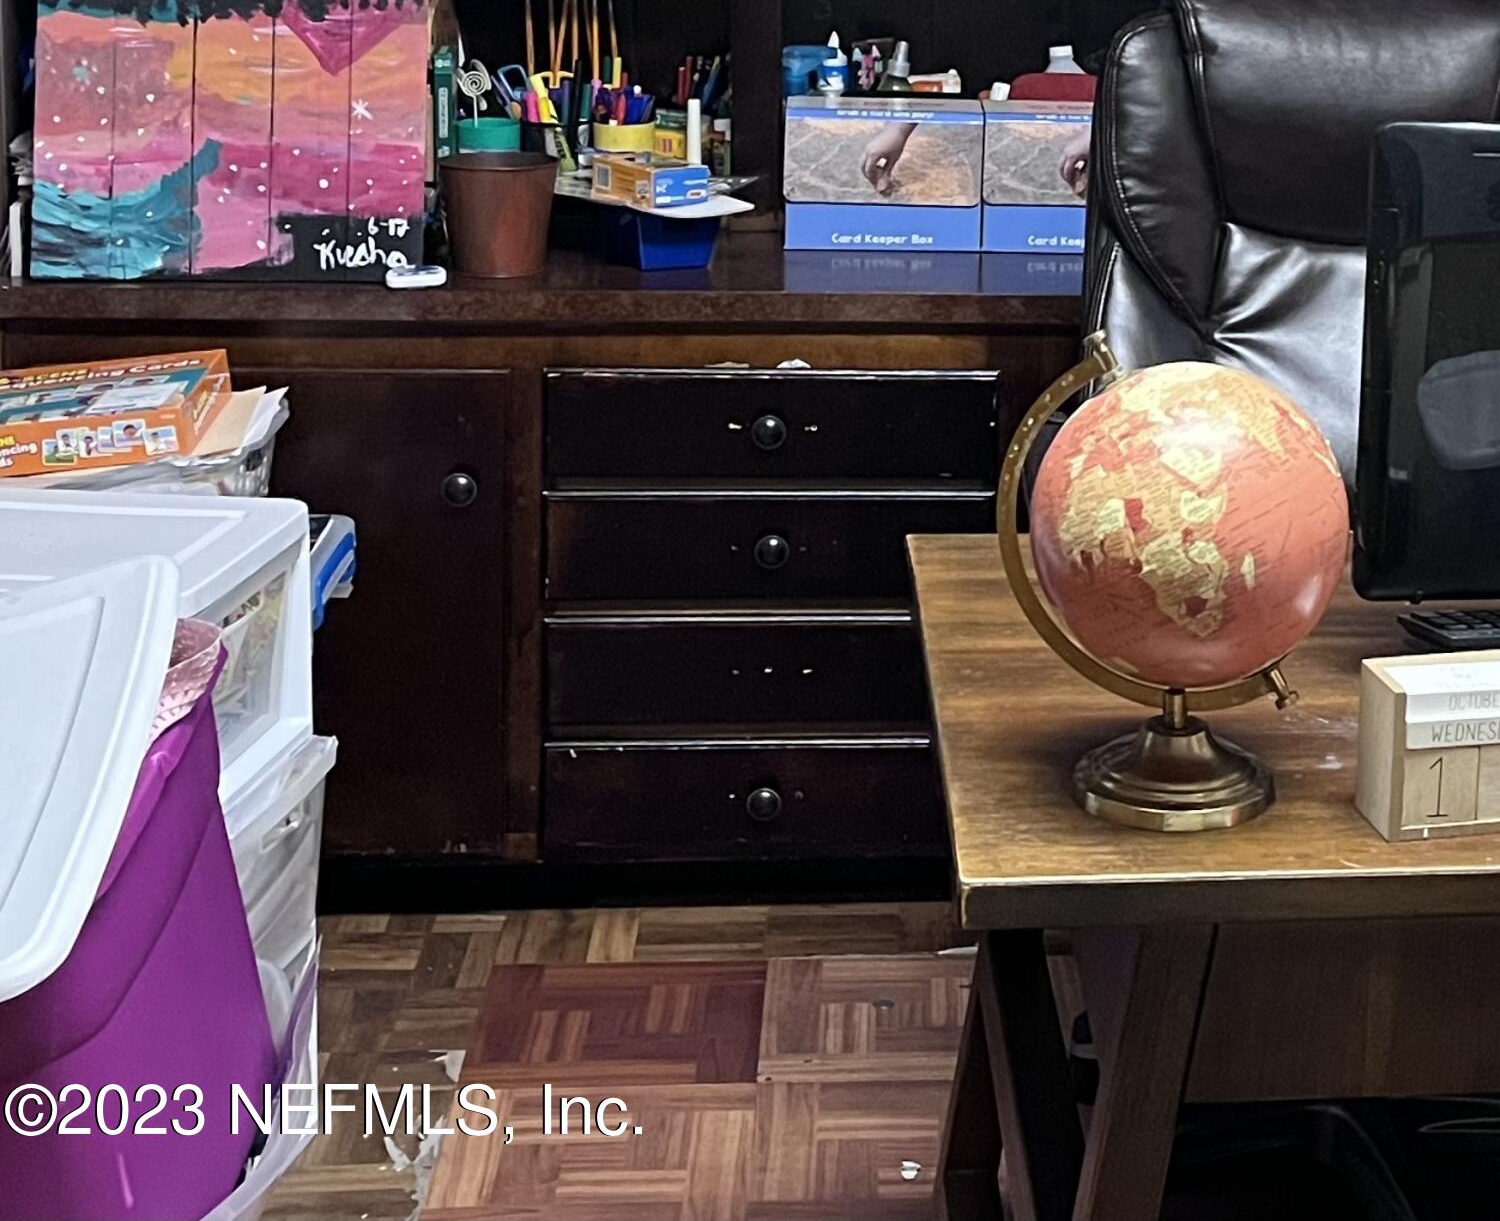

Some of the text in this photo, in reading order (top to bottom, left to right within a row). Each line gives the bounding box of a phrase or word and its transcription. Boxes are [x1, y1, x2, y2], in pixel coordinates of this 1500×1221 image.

[831, 233, 933, 247] Card Keeper Box
[1028, 235, 1058, 246] Card
[129, 359, 200, 373] Cards
[1426, 756, 1449, 818] 1
